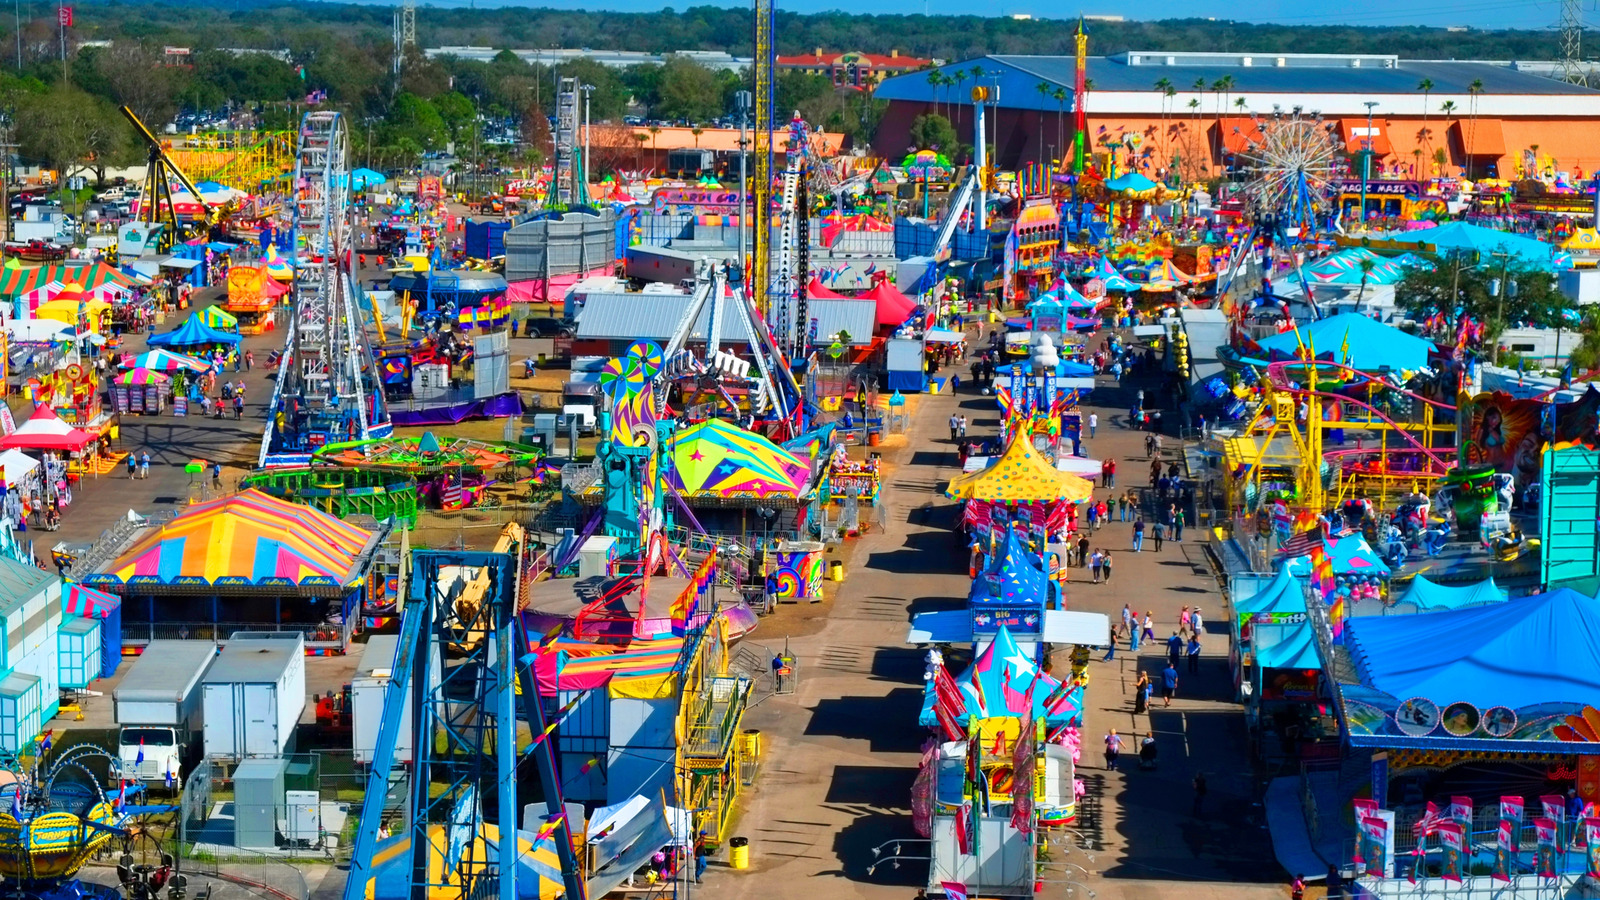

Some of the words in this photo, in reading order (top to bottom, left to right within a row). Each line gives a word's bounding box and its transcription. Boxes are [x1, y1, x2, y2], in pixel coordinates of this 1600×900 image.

[507, 180, 546, 192] PIZZA
[1341, 184, 1371, 193] MAGC
[1377, 184, 1407, 193] MAZE
[994, 611, 1009, 619] BIG
[963, 804, 973, 851] PIZZA
